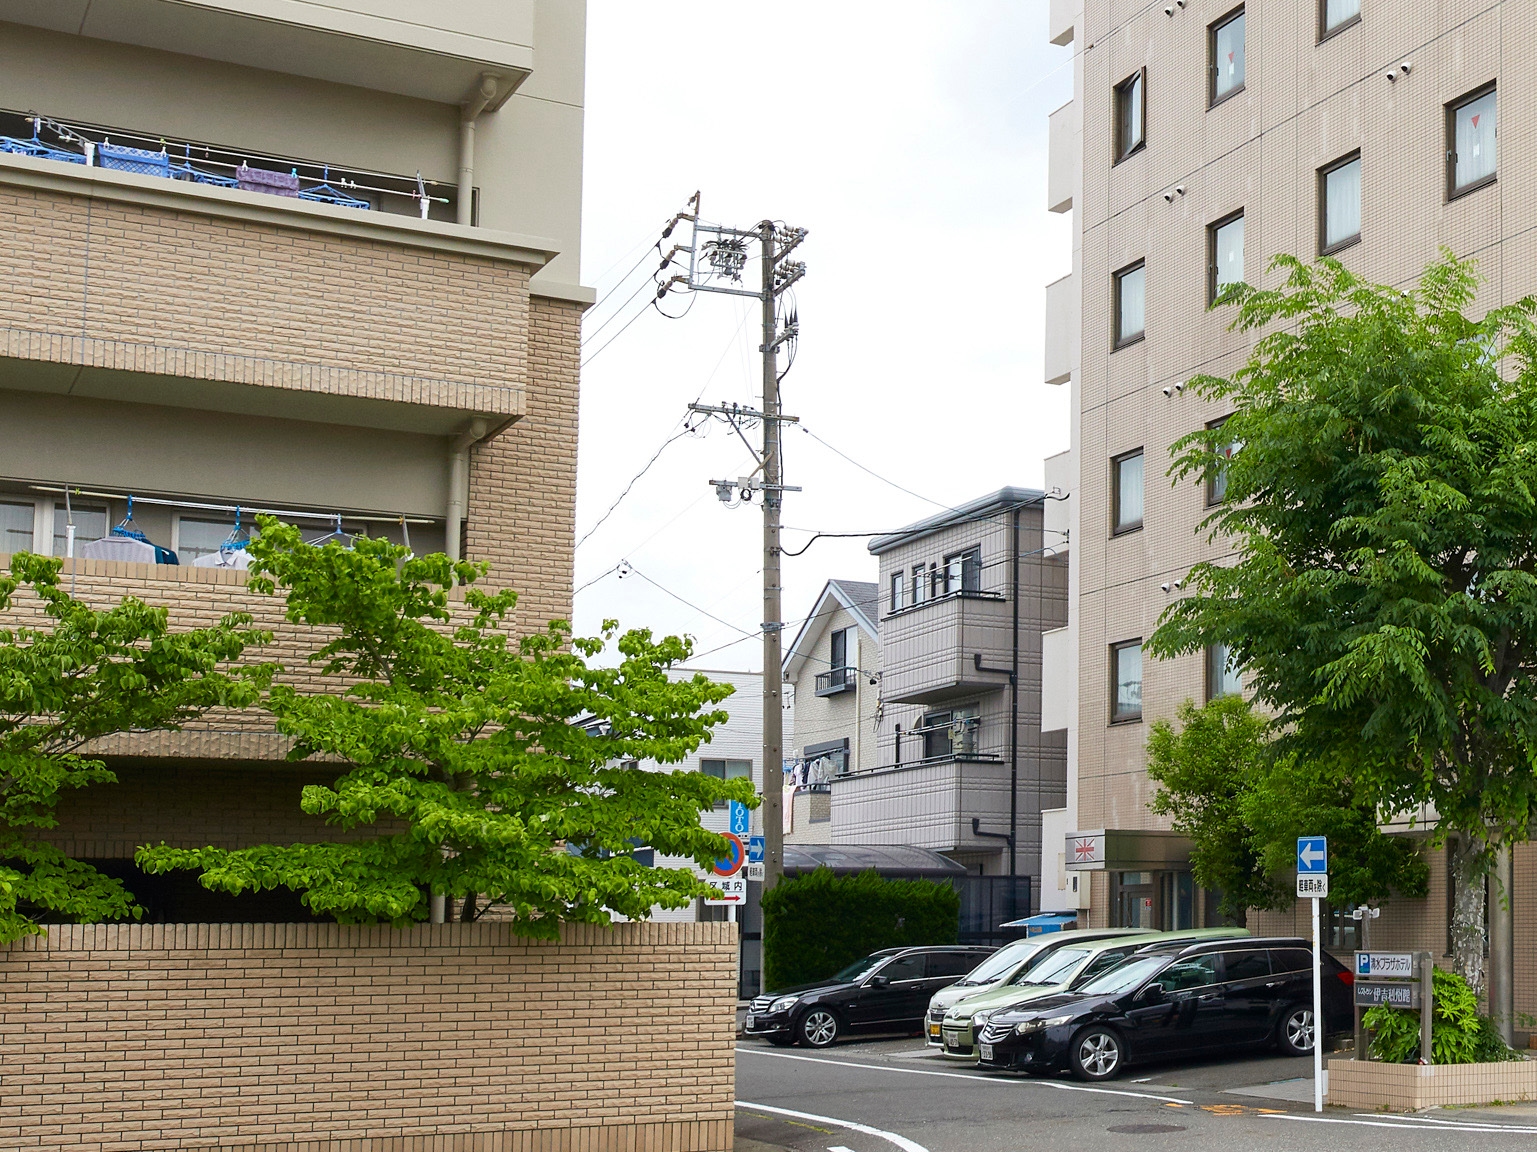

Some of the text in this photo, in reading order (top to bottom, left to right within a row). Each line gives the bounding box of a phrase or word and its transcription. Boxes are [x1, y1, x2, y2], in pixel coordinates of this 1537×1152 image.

[1371, 957, 1411, 971] 清水プラザホテル
